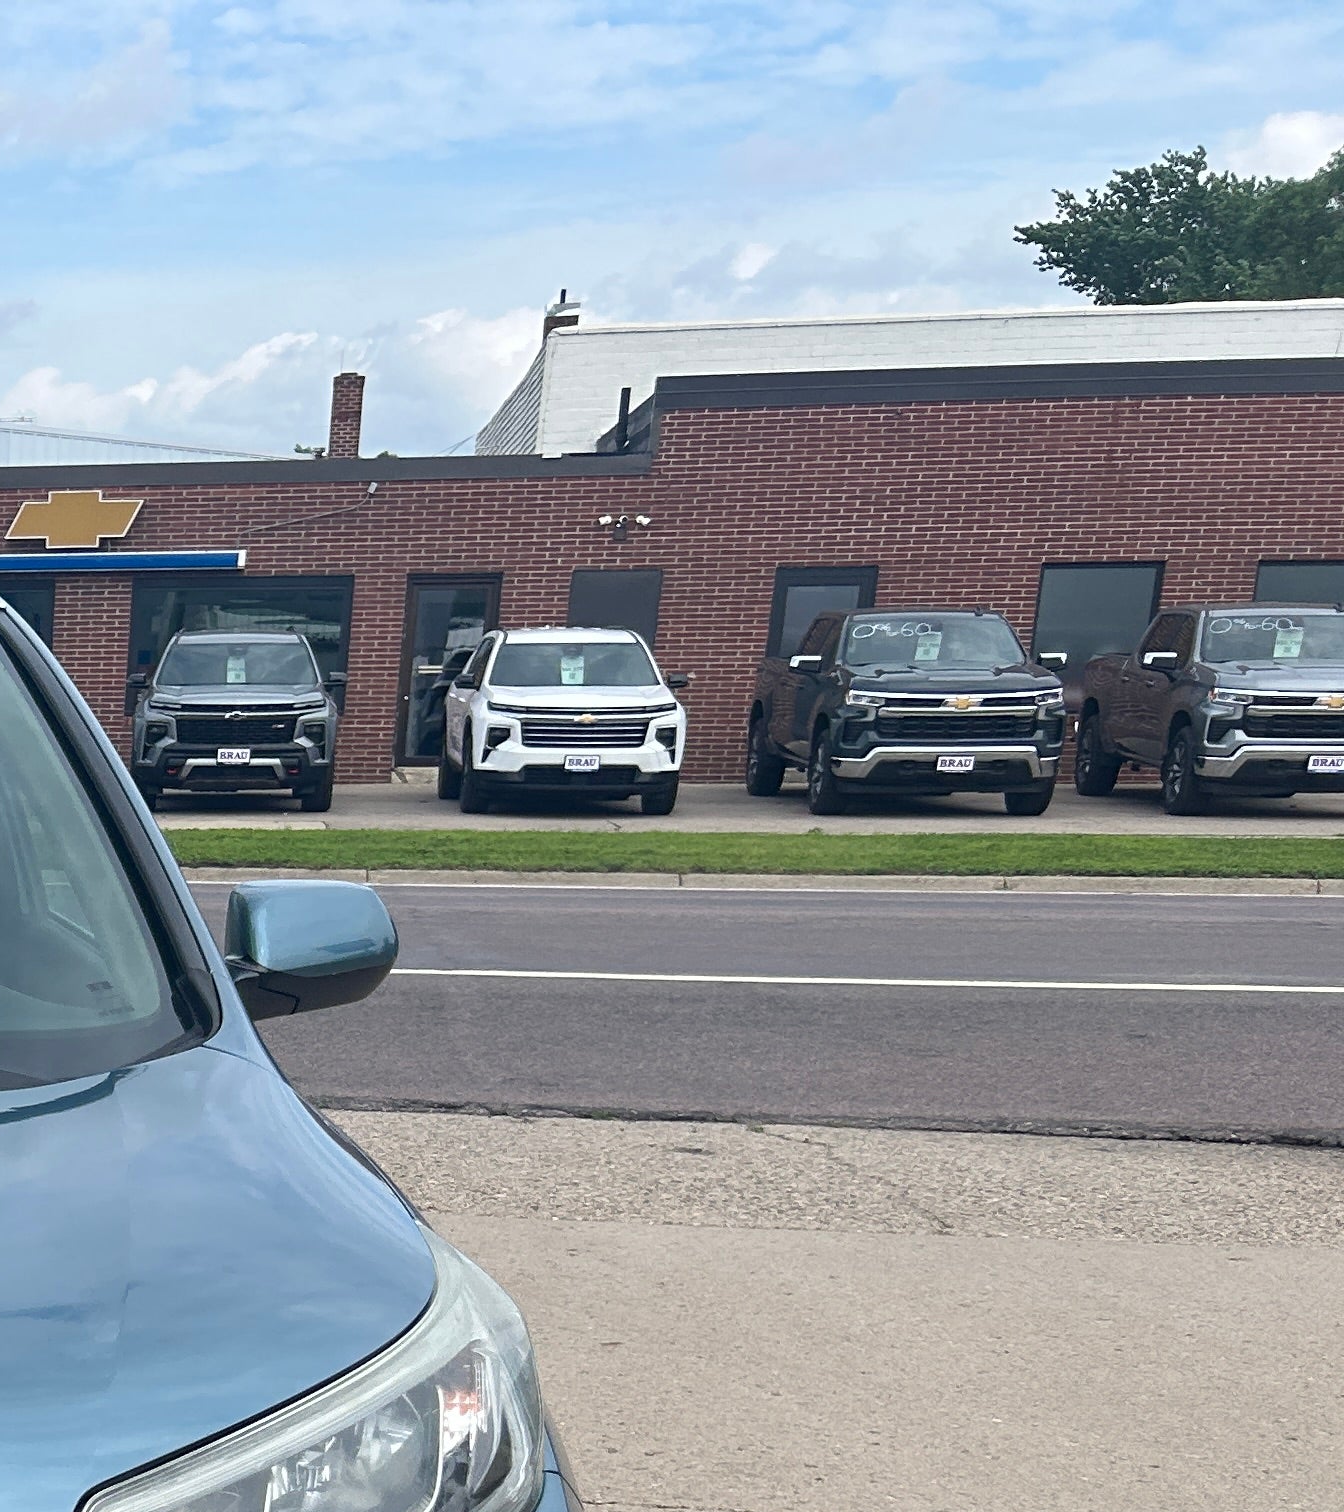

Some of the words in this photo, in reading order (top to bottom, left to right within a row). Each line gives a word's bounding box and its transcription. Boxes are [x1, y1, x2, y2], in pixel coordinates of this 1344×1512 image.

[1262, 617, 1293, 631] 60
[220, 751, 248, 760] BRAU
[567, 758, 597, 767] BRAU
[939, 758, 972, 767] BRAU
[1312, 758, 1344, 767] BRAU
